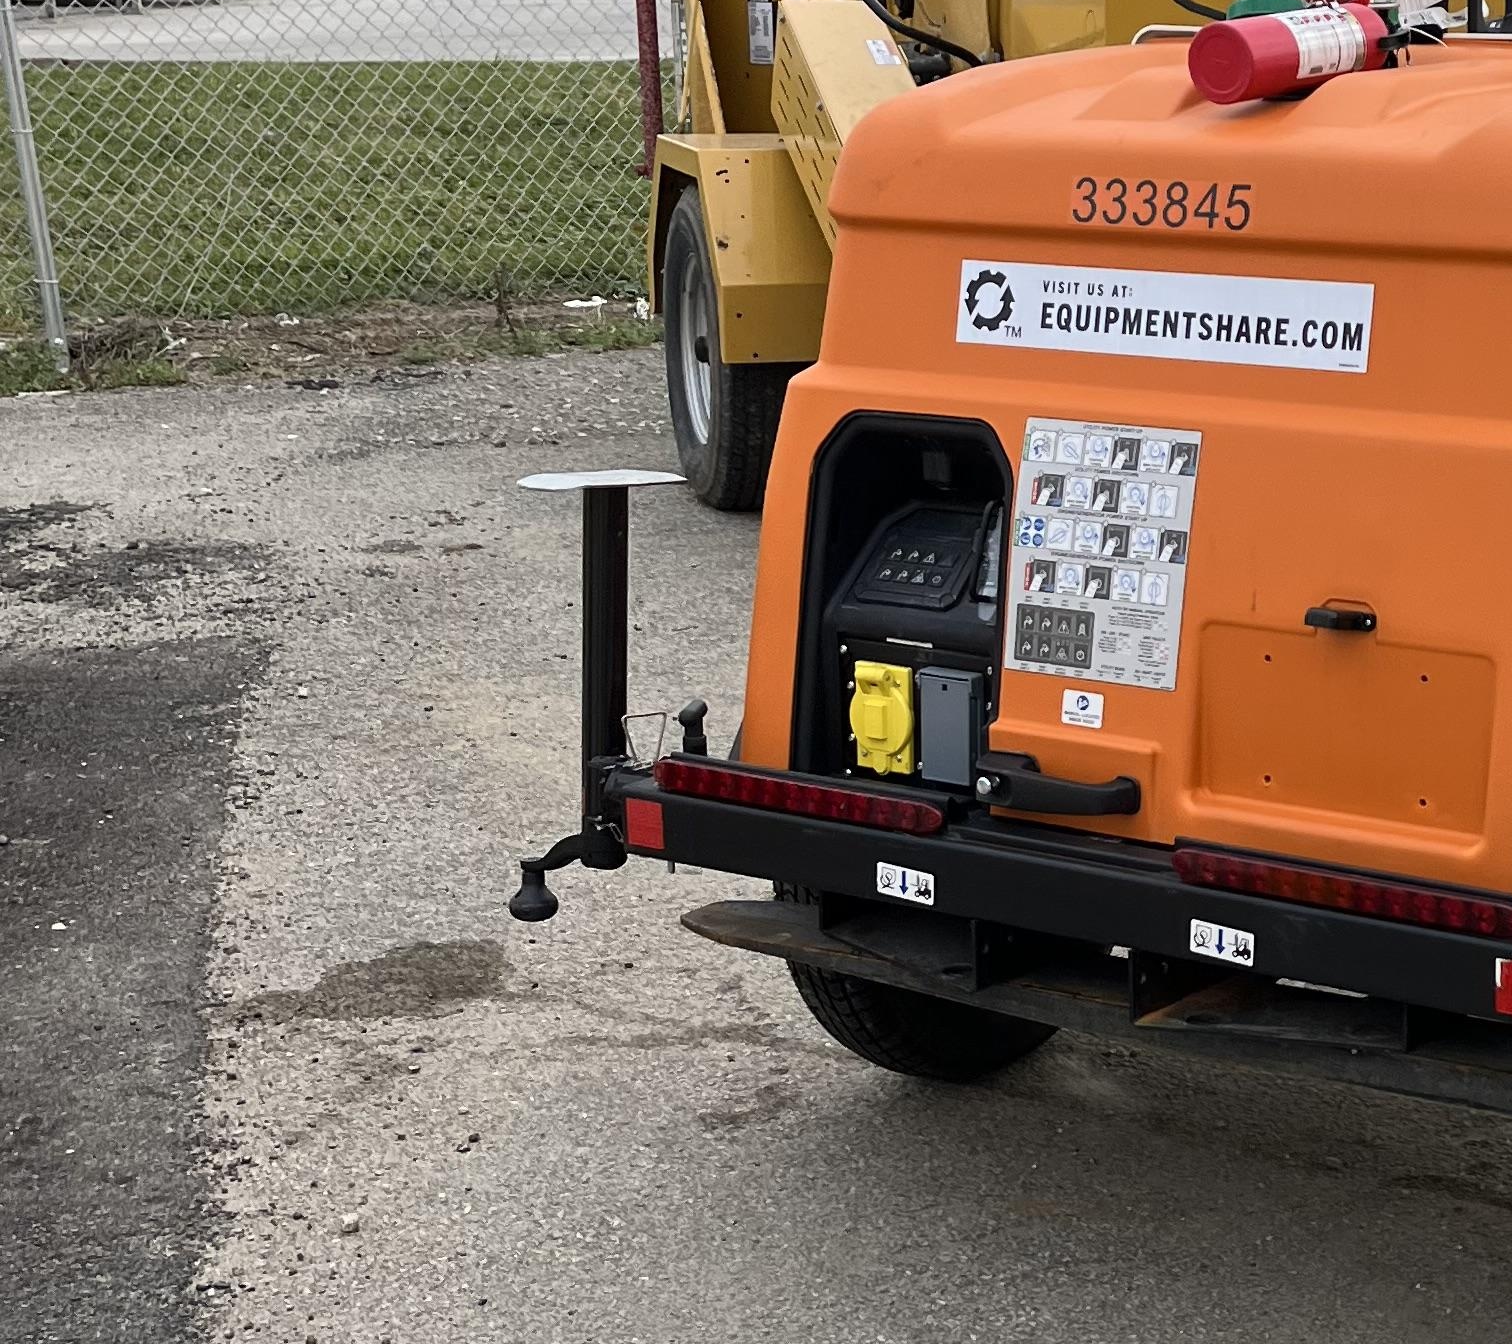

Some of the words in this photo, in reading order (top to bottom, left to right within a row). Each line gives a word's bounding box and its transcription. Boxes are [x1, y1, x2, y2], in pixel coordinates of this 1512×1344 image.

[1072, 176, 1252, 230] 333845
[1042, 280, 1080, 295] VISIT
[1087, 283, 1104, 297] US
[1111, 285, 1133, 298] AT:
[1040, 302, 1364, 353] EQUIPMENTSHARE.COM
